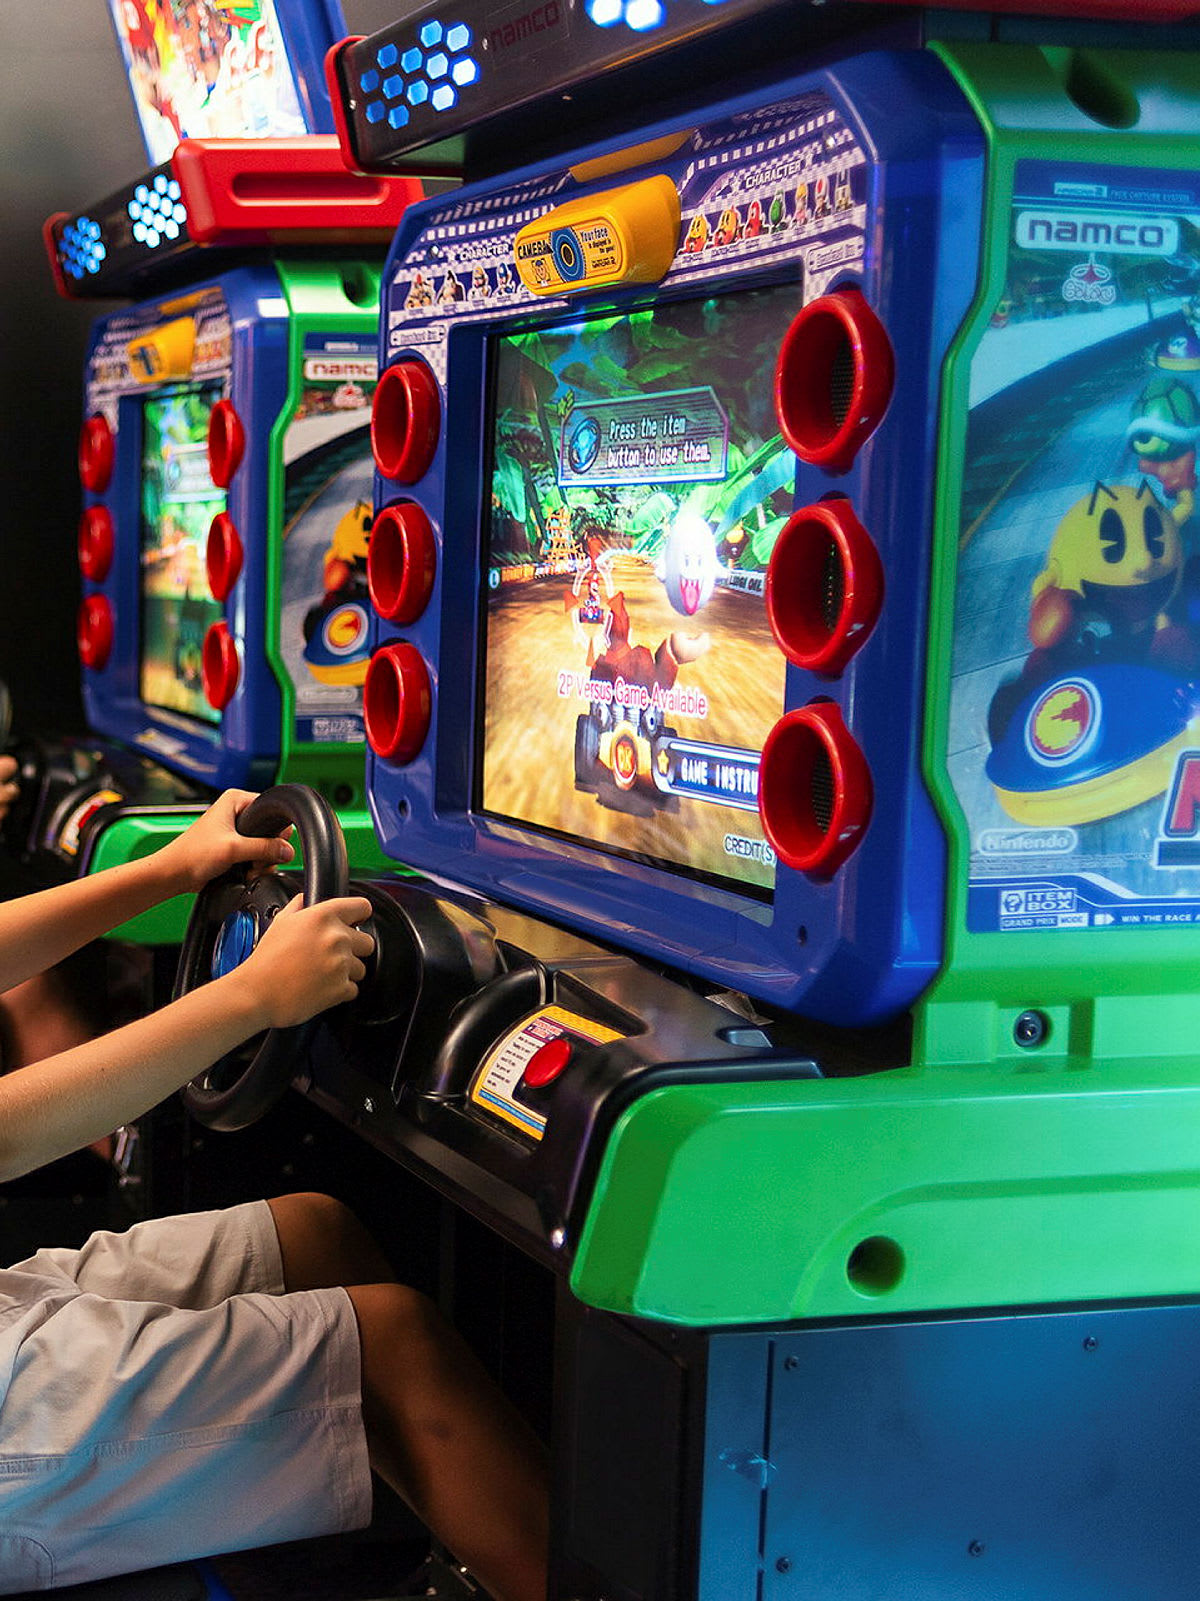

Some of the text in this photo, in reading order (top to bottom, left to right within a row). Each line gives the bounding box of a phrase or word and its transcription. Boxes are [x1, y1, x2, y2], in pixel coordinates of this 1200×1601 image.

[489, 1, 560, 51] namco
[745, 162, 801, 188] CHARACTER
[1028, 218, 1164, 247] namco
[517, 240, 551, 259] CAMERA
[609, 414, 686, 440] Press the item
[607, 440, 711, 468] button to use them.
[558, 672, 707, 716] 2P Versus Game Available
[681, 757, 708, 785] GAME
[985, 834, 1068, 850] Nintendo
[1027, 891, 1073, 901] ITEM
[1027, 901, 1072, 910] BOX
[1143, 914, 1163, 922] THE
[1165, 913, 1192, 921] RACE
